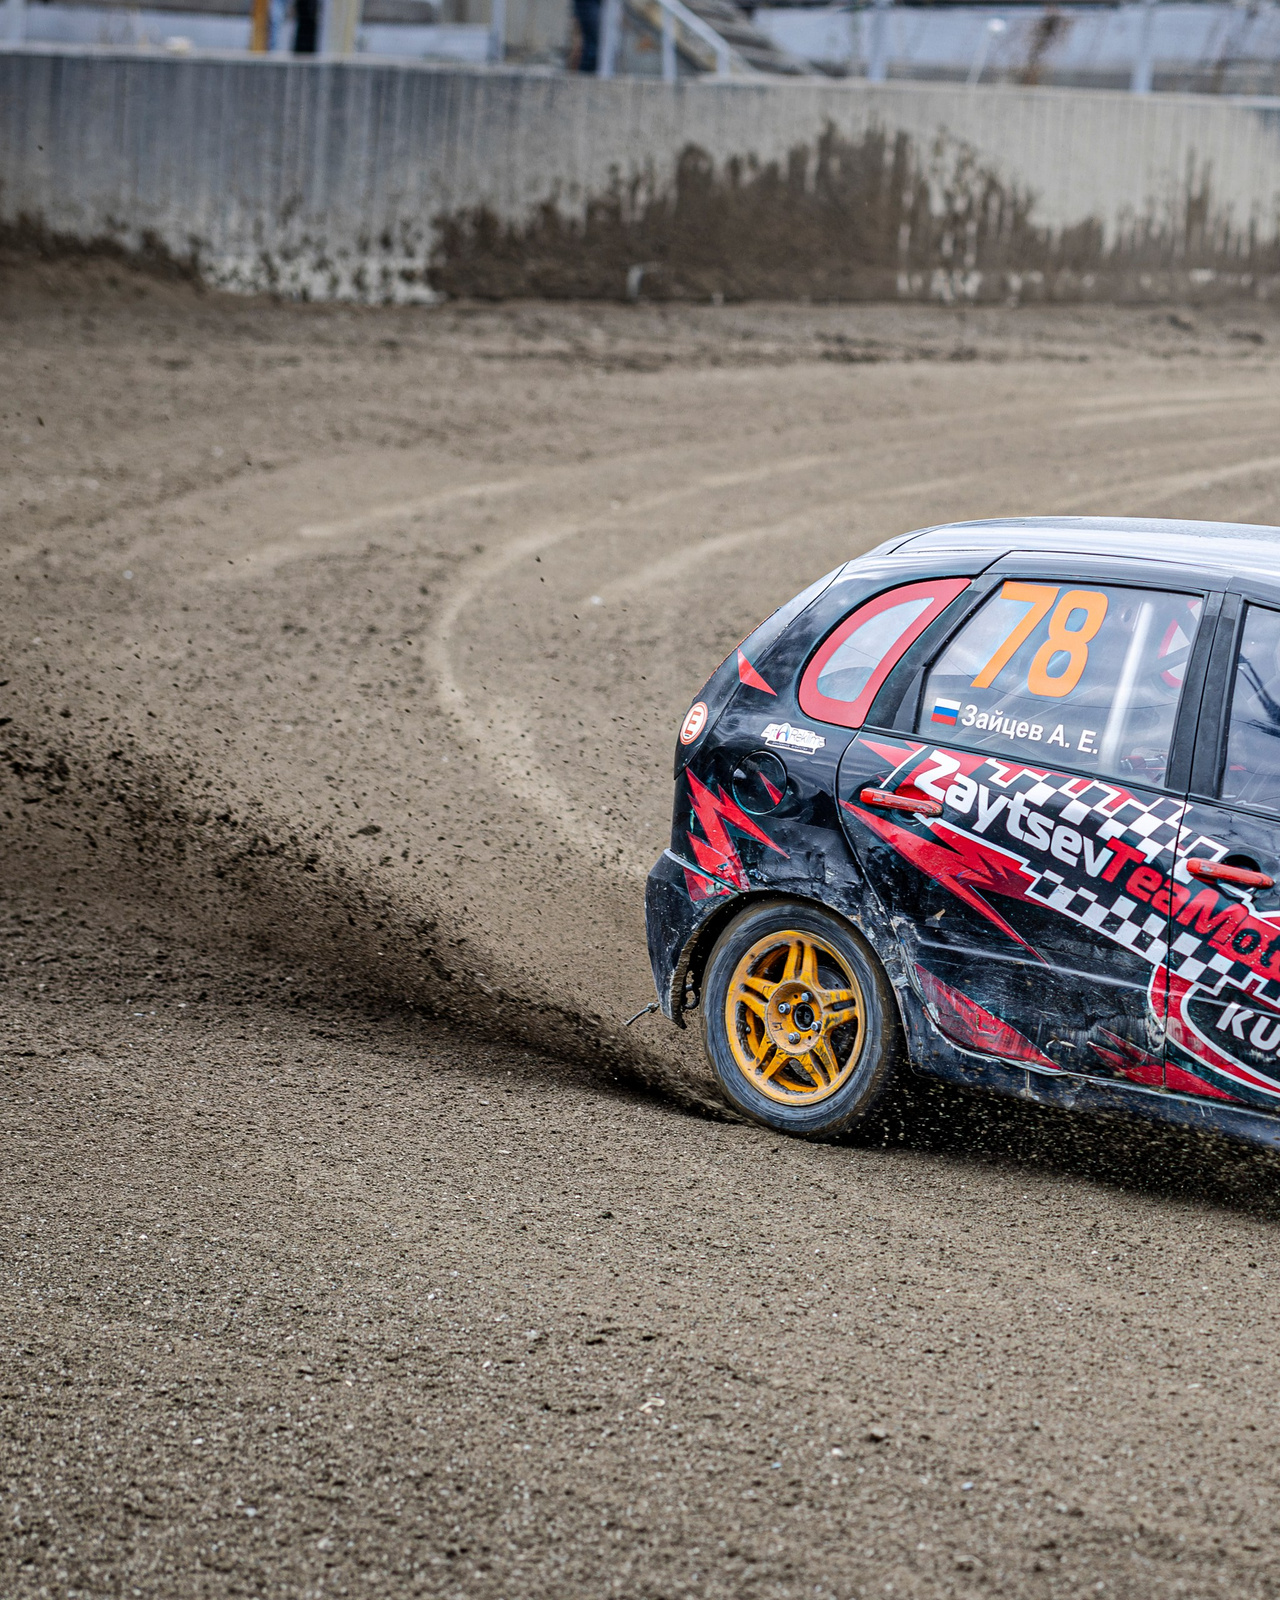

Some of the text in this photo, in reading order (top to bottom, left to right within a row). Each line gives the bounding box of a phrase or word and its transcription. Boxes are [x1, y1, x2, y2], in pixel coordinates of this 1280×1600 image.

[969, 581, 1109, 698] 78
[960, 703, 1099, 754] Зайцев А. Е.
